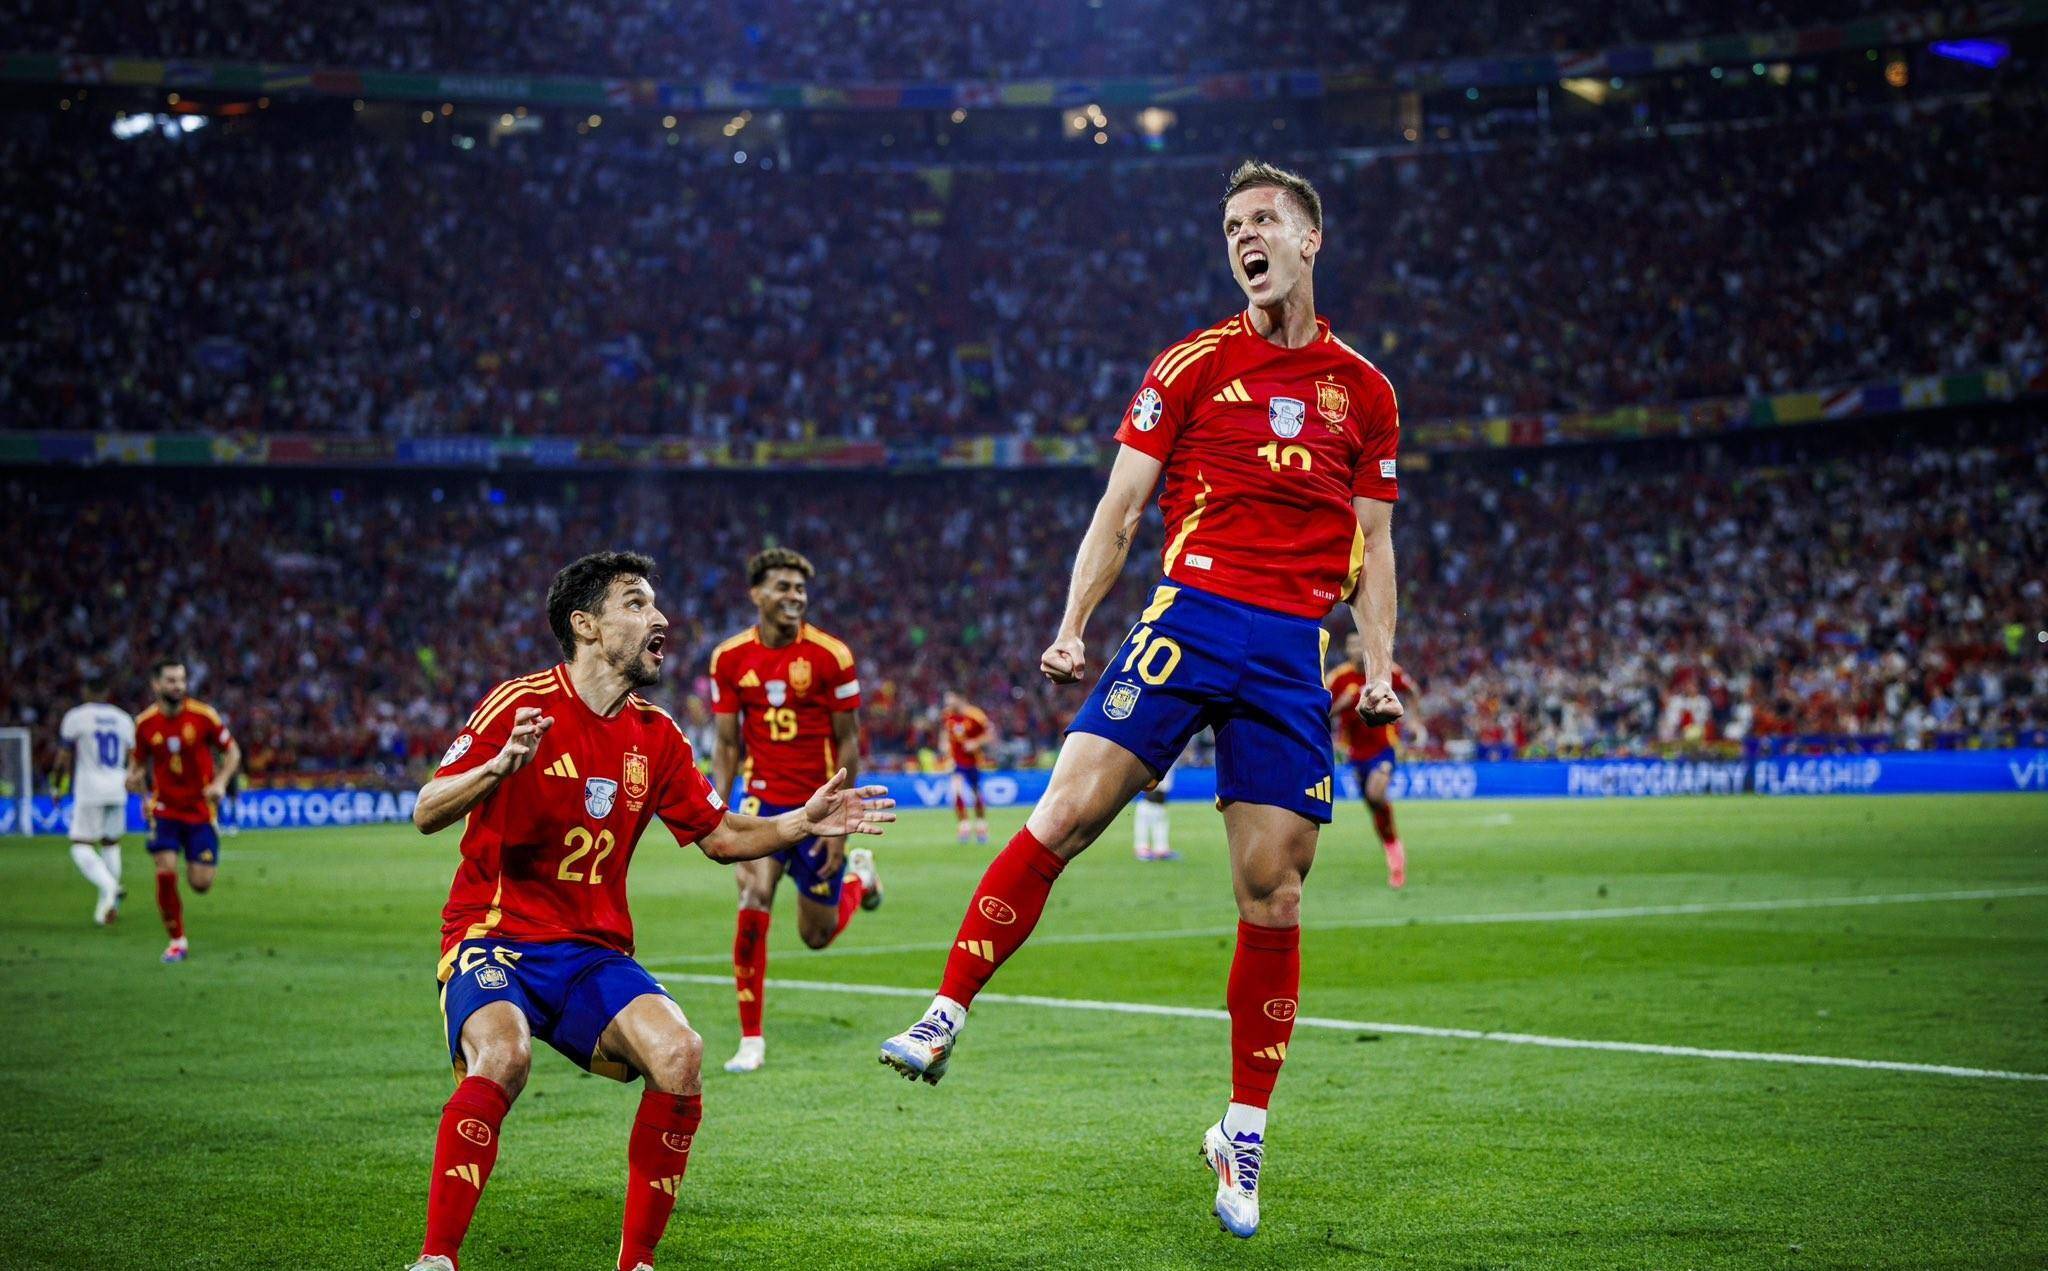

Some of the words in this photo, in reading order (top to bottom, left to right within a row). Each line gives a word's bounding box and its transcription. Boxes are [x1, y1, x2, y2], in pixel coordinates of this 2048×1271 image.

[1121, 625, 1182, 685] 10
[763, 707, 798, 741] 19
[94, 730, 120, 768] 10
[557, 826, 615, 885] 22
